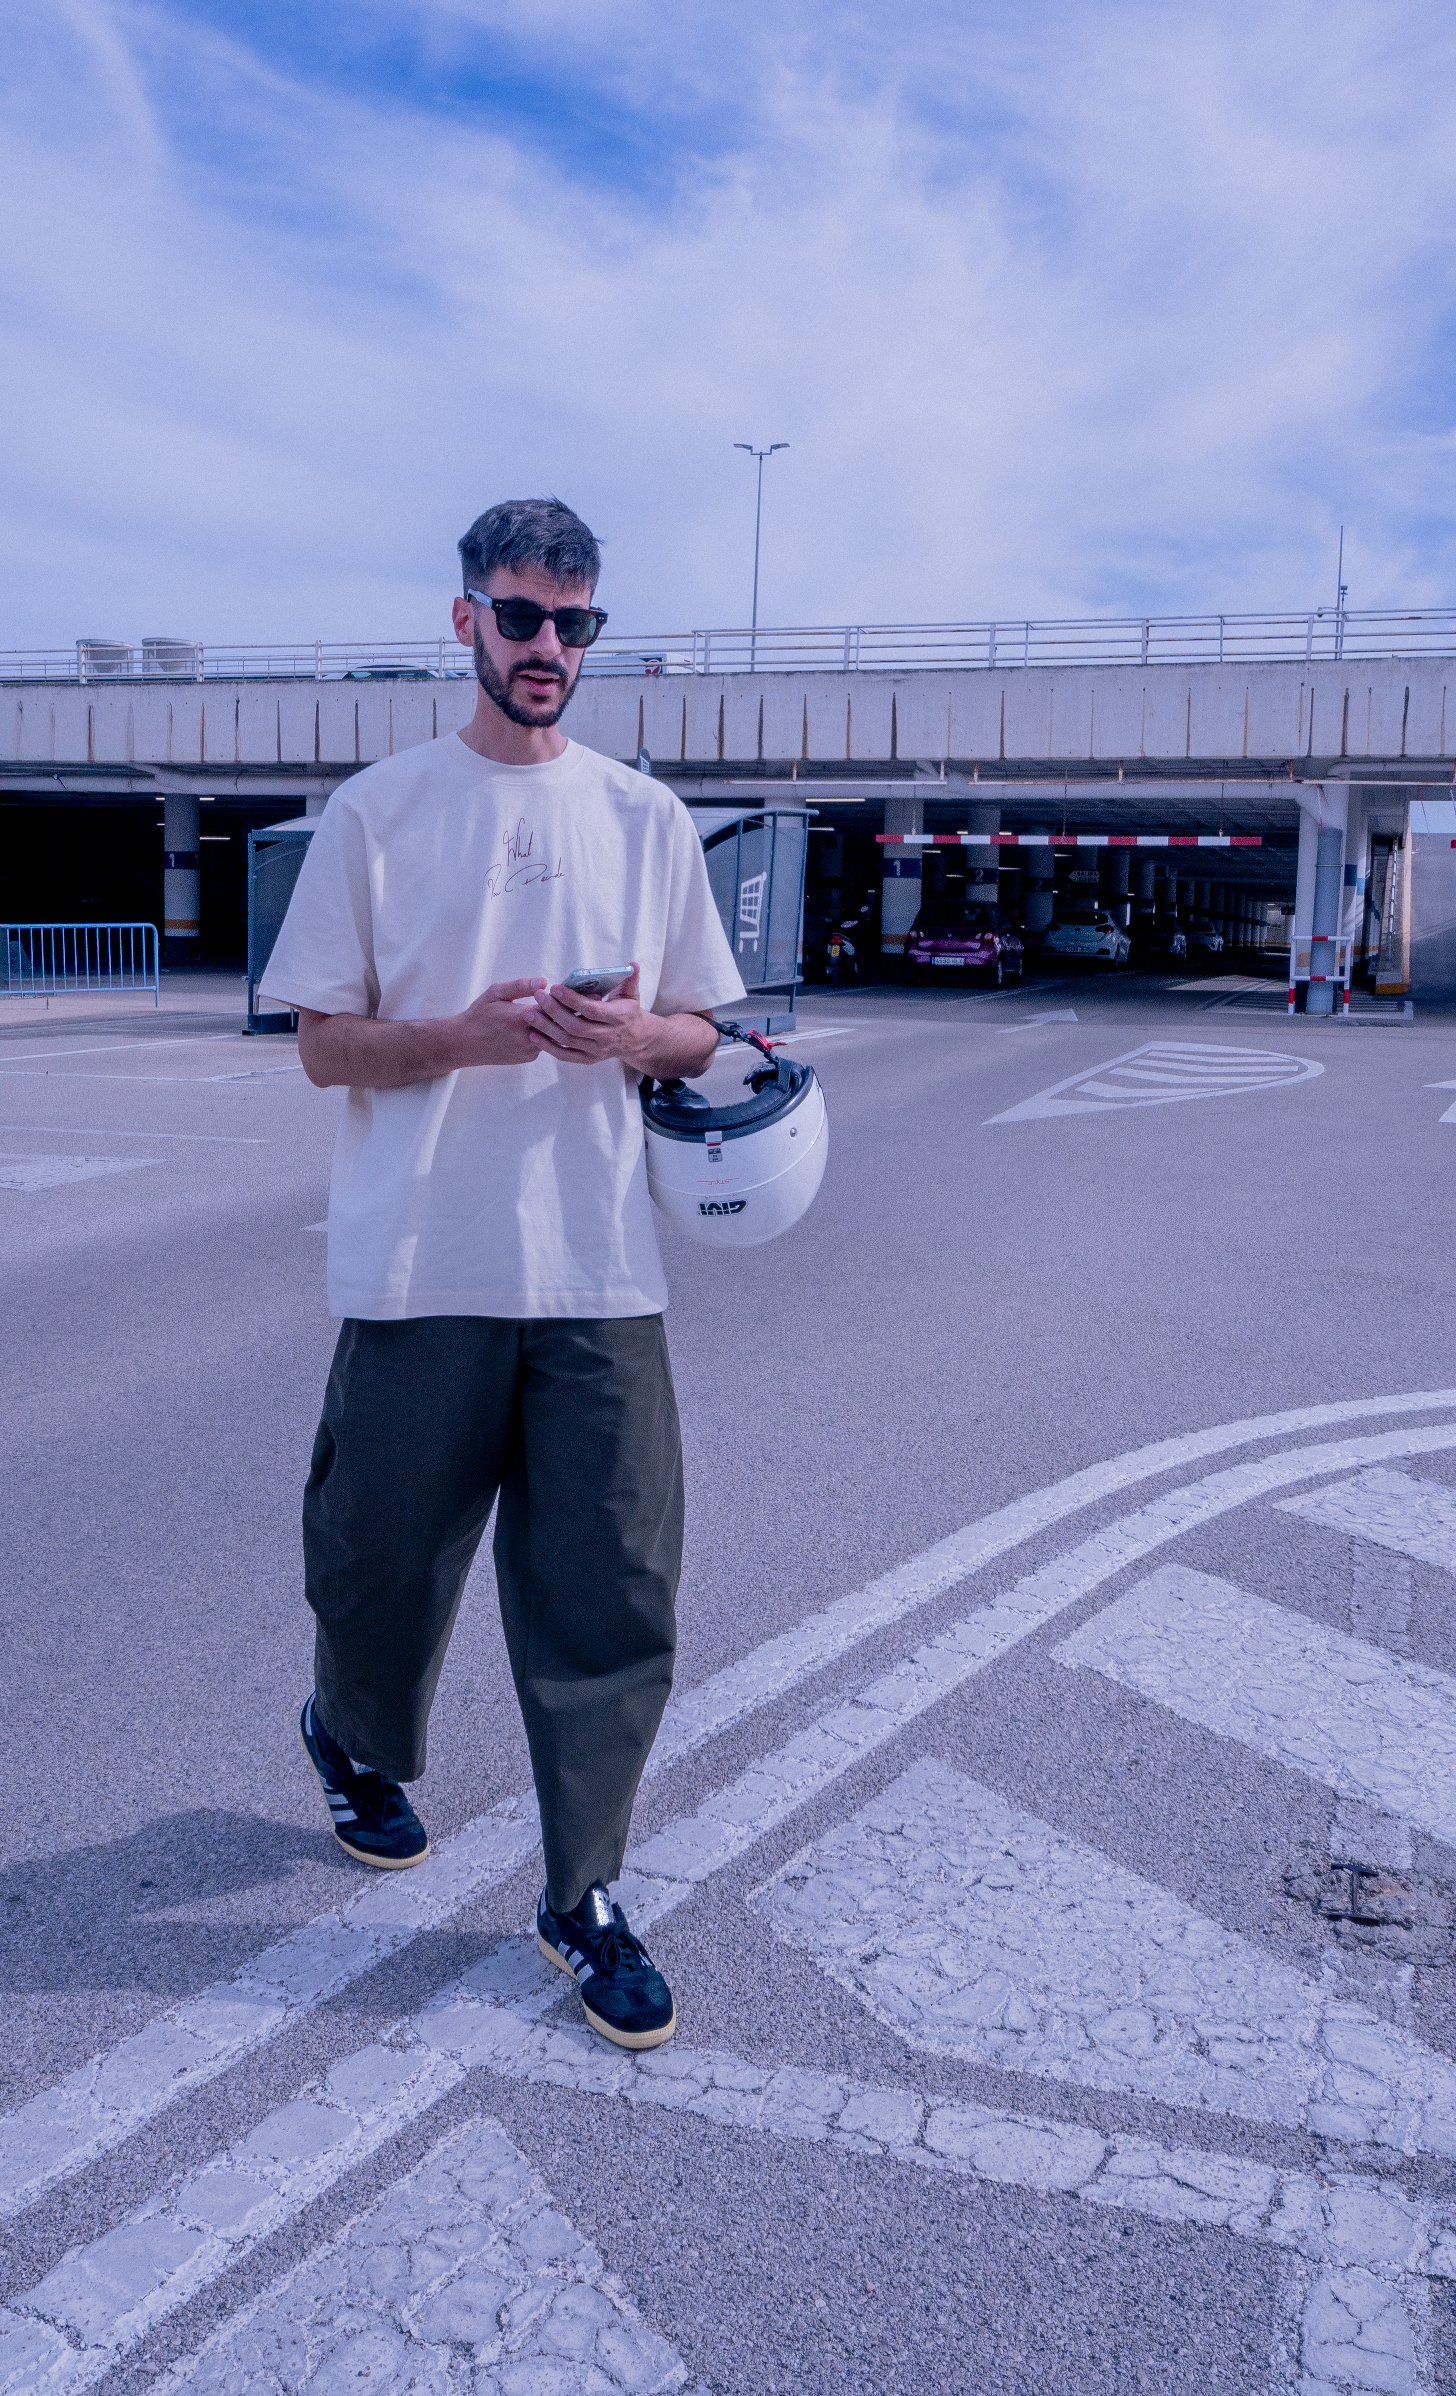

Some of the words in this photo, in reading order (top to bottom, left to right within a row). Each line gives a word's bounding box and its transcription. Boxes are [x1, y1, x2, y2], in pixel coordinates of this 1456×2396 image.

[168, 852, 175, 868] 1
[893, 859, 901, 876] 1
[974, 869, 984, 883] 2
[1034, 879, 1042, 890] 2
[699, 1199, 747, 1216] GIVI
